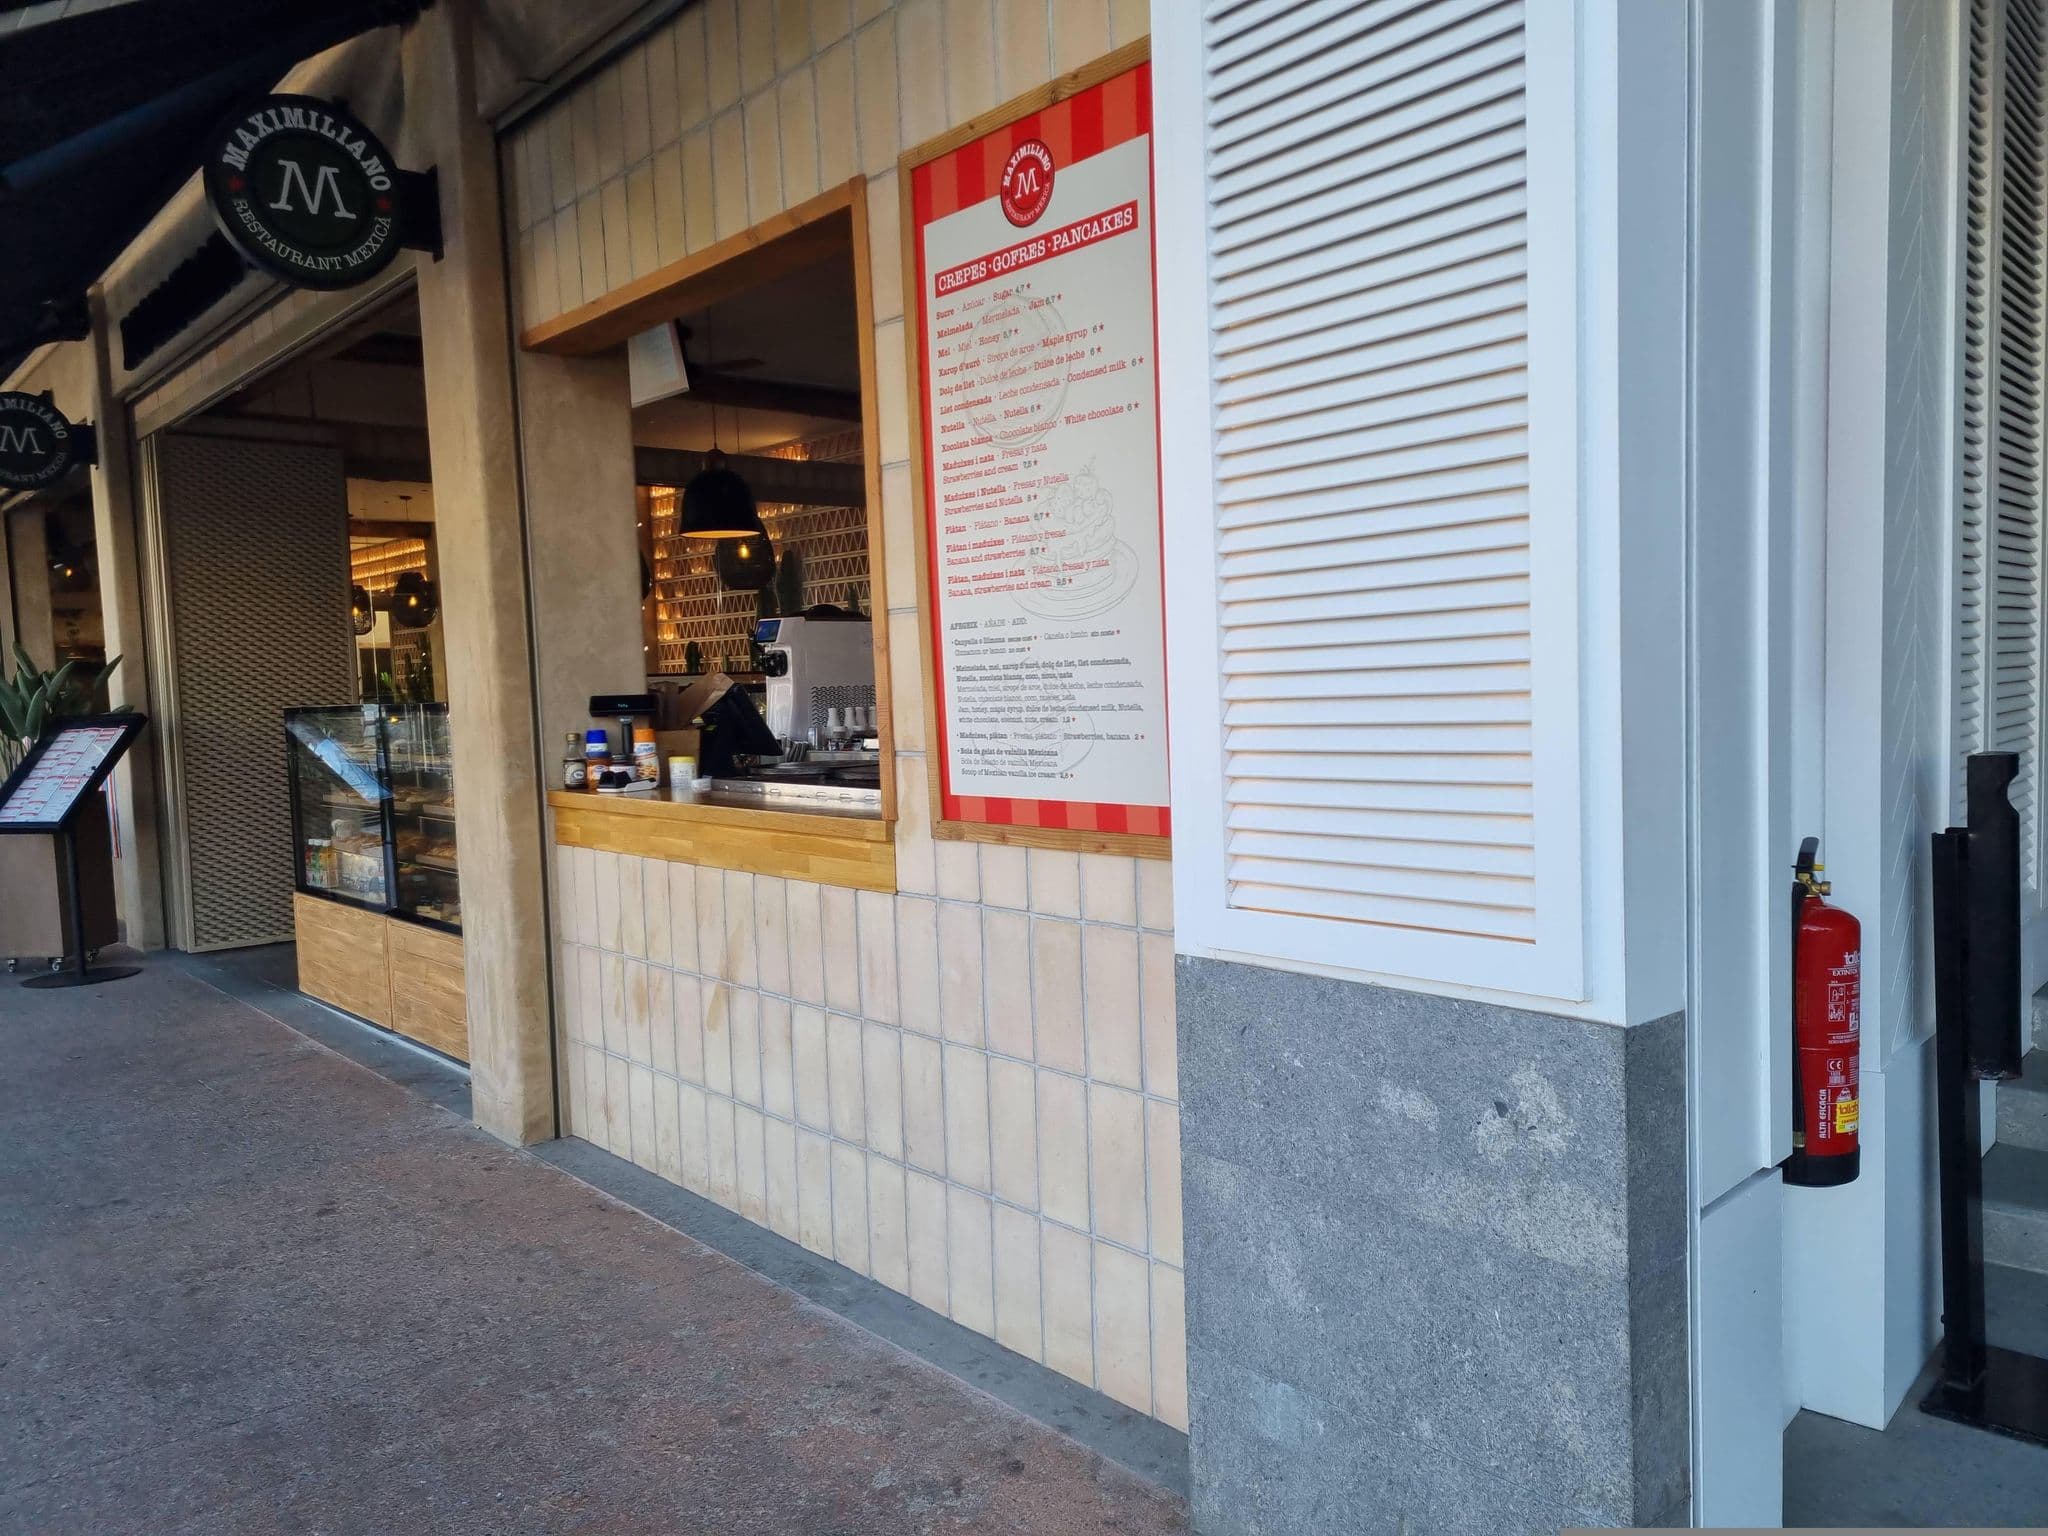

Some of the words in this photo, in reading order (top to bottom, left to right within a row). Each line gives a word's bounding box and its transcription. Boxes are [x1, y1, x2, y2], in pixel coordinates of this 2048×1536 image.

[222, 106, 391, 192] MAXIMILIANO
[1003, 144, 1051, 187] MAXIMILIANO
[270, 159, 357, 220] M
[1015, 168, 1040, 199] M
[234, 199, 342, 271] RESTAURANT
[938, 261, 987, 291] CREPES
[992, 240, 1046, 272] GOFRES
[1052, 208, 1132, 252] PANCAKES
[993, 288, 1013, 301] Sugar
[1065, 328, 1088, 342] syrup
[1067, 364, 1107, 383] Condensed
[1088, 406, 1124, 420] chocolate
[0, 425, 46, 454] M
